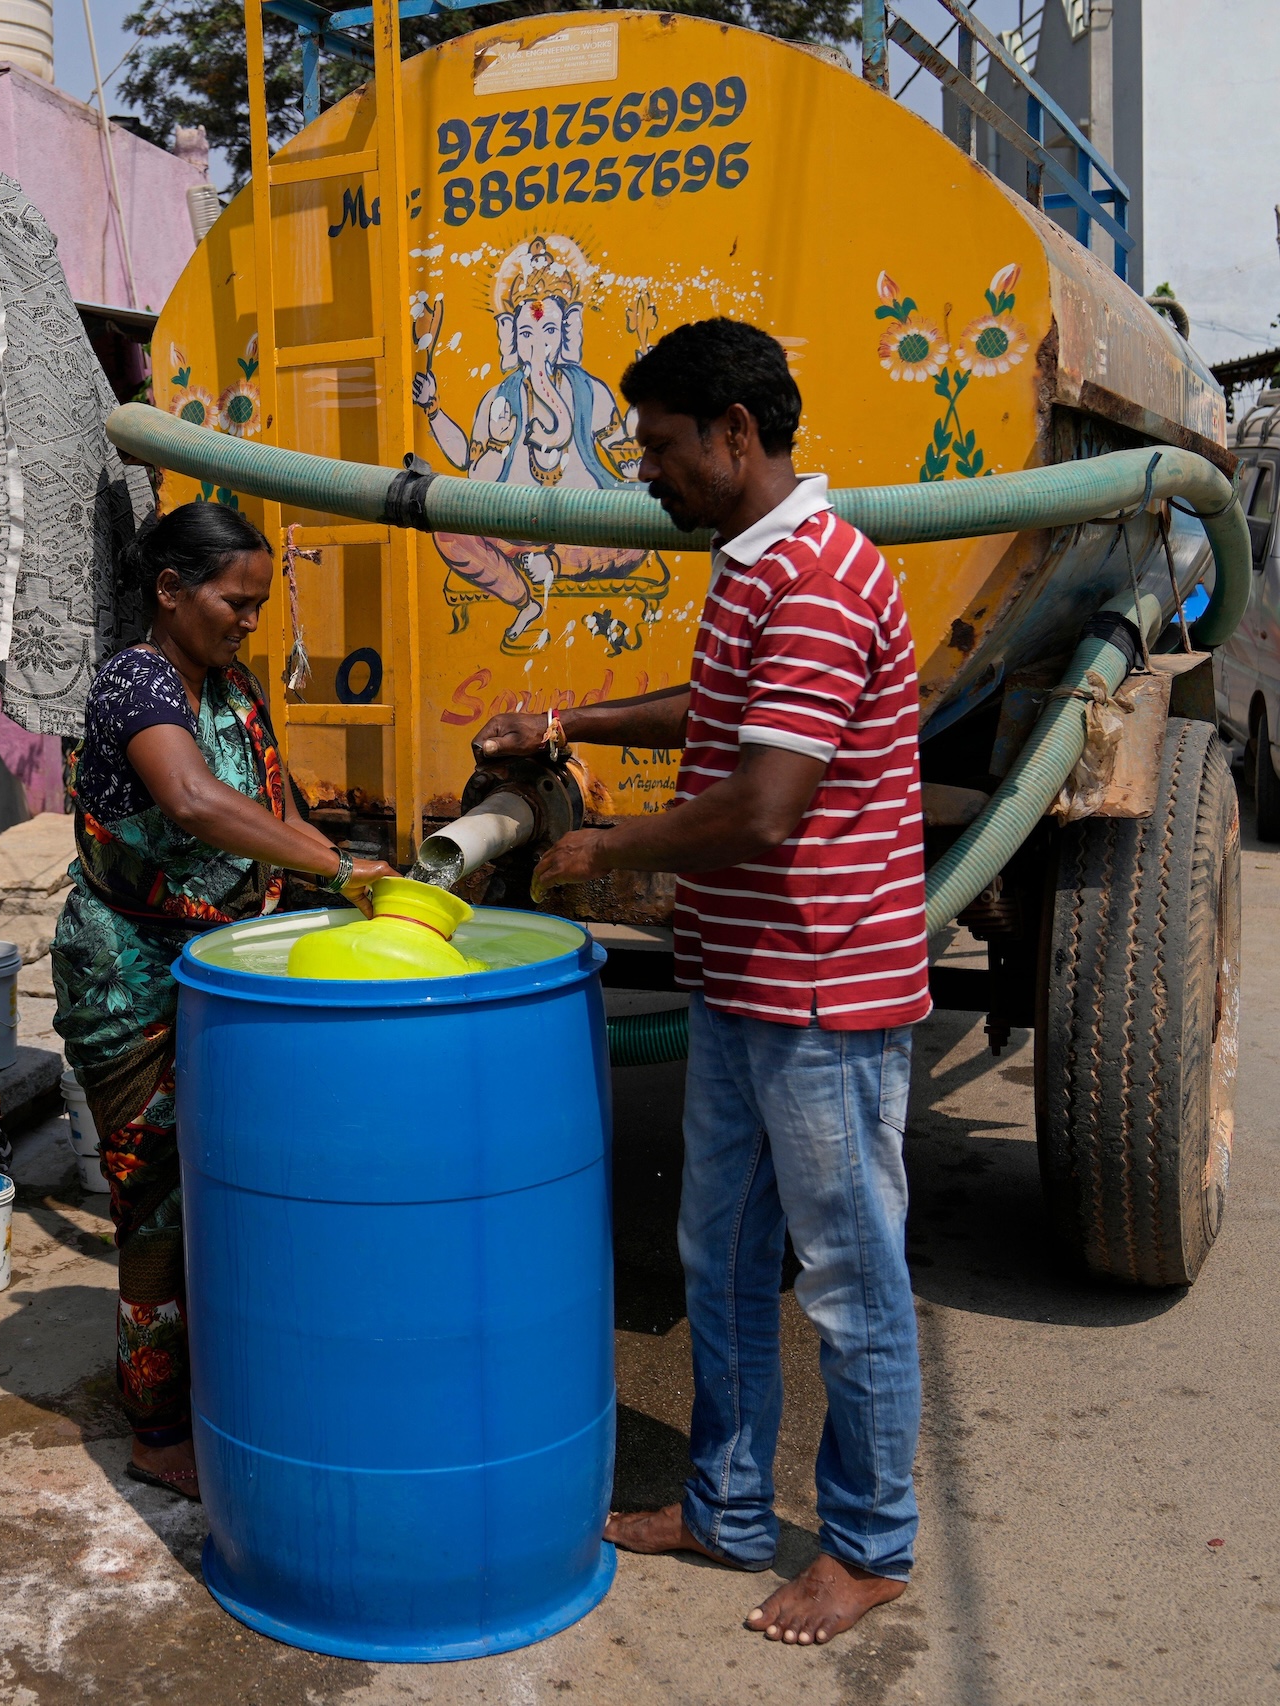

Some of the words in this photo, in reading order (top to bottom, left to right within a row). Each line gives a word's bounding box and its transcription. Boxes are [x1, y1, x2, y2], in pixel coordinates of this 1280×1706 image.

[526, 44, 580, 58] ENGINEERING
[583, 40, 612, 50] WORKS
[437, 76, 748, 174] 9731756999
[442, 142, 752, 227] 8861257696
[440, 668, 614, 726] Sound
